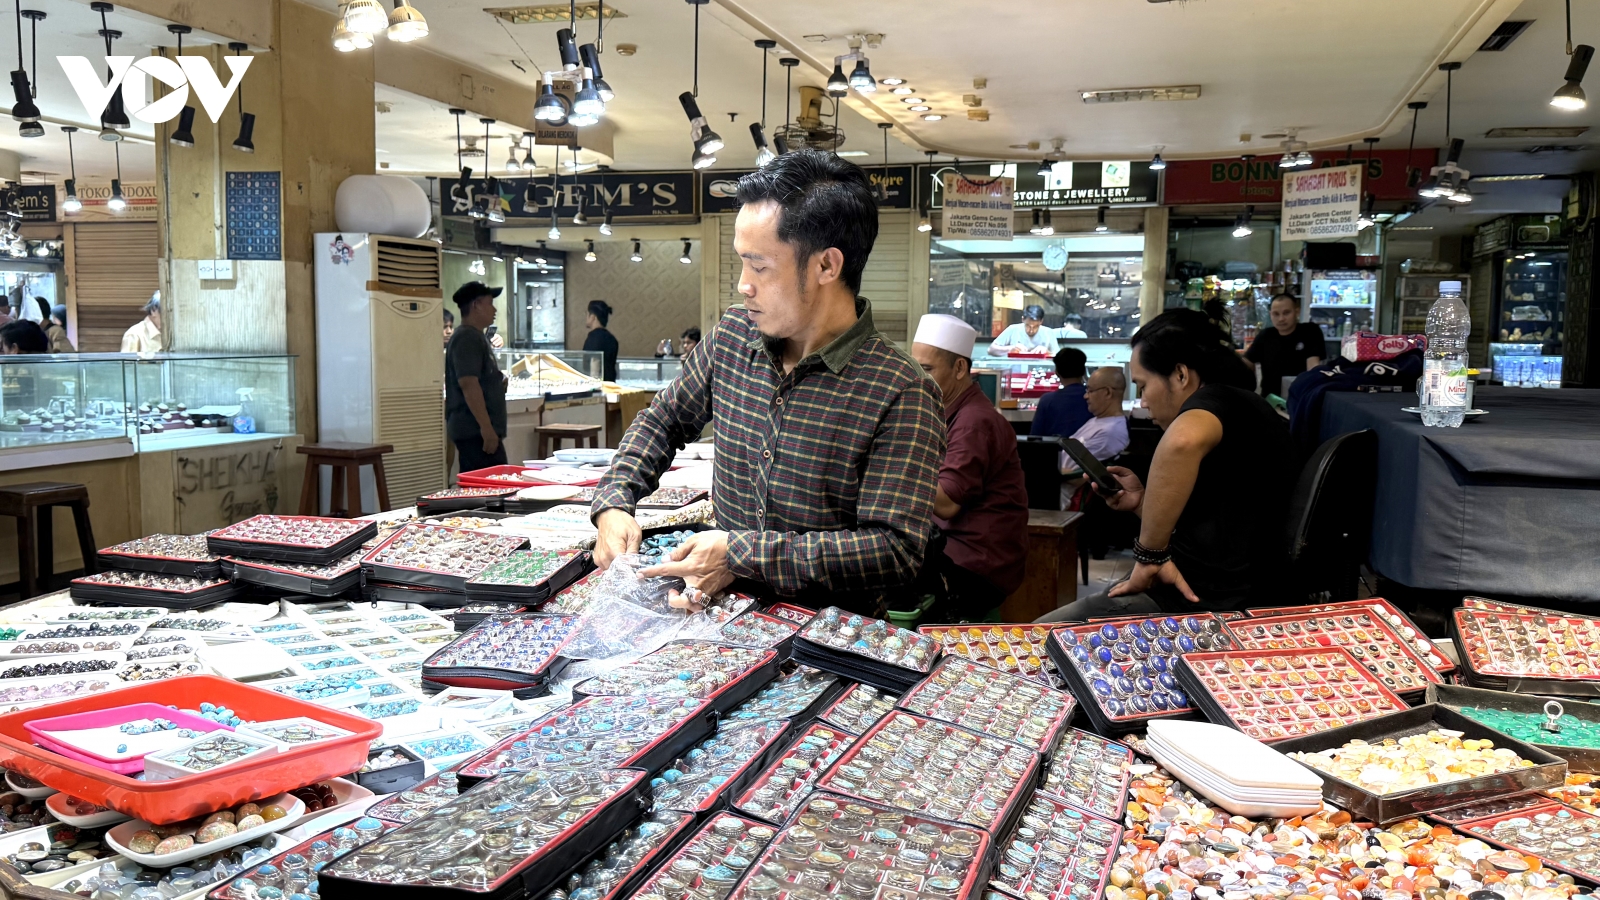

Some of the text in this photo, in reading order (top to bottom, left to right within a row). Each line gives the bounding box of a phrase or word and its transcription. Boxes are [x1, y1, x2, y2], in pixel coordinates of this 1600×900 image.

[869, 173, 904, 187] Store
[1296, 171, 1347, 193] SAHABAT PIRUS
[78, 186, 110, 199] TOKO
[524, 182, 677, 207] GEM'S
[1052, 190, 1060, 199] &
[1064, 188, 1130, 199] JEWELLERY
[1289, 209, 1352, 220] Jakarta Gems Center
[1315, 218, 1329, 226] CCT
[1382, 340, 1405, 350] jolly
